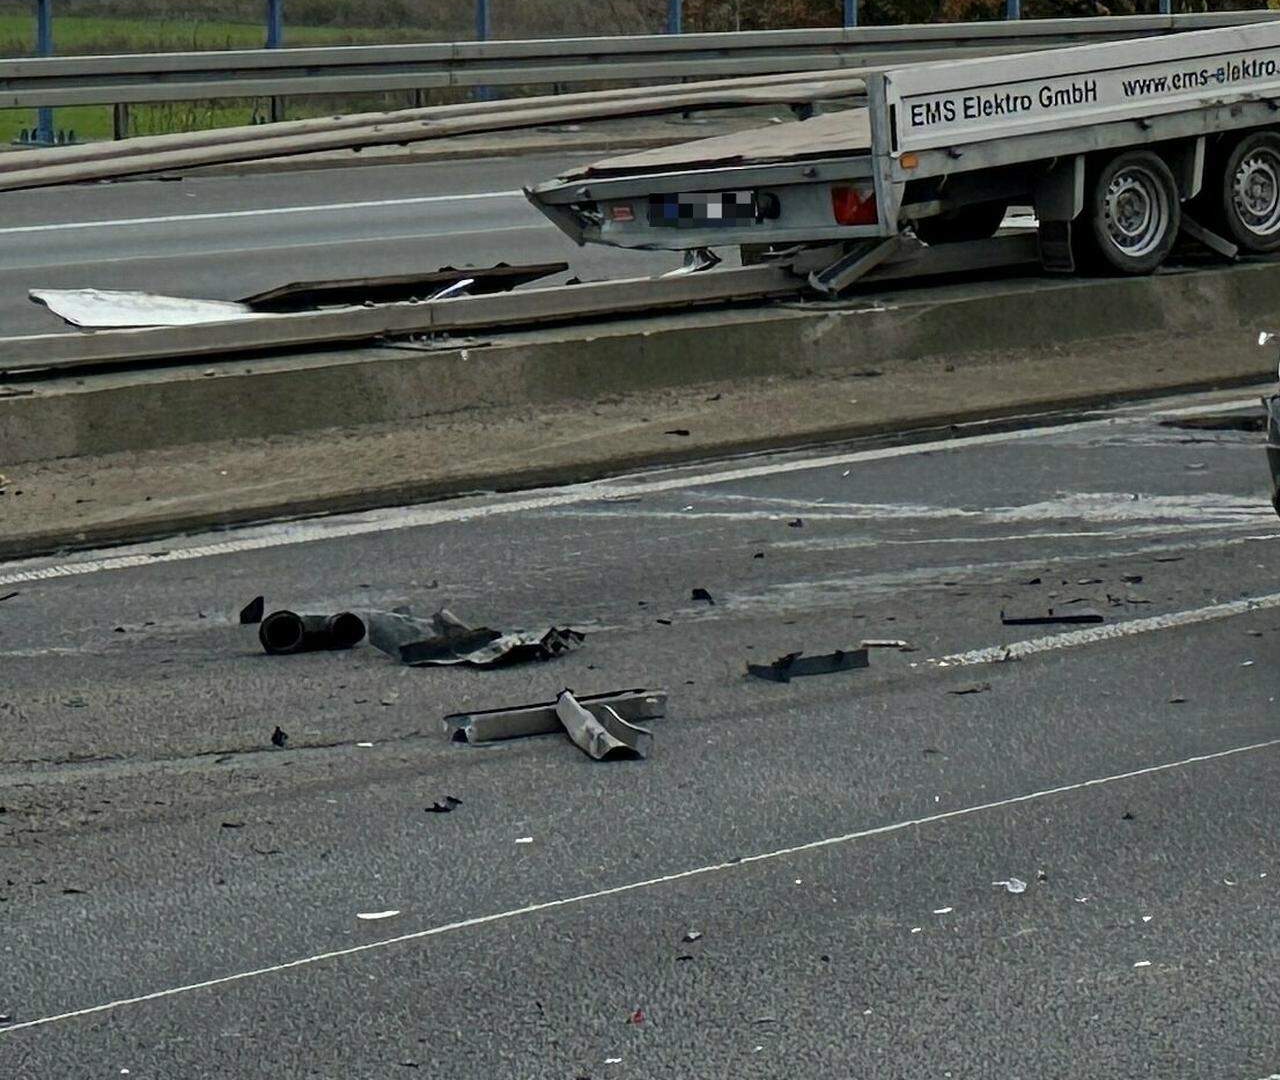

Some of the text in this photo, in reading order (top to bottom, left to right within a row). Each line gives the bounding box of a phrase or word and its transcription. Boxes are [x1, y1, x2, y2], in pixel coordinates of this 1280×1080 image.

[910, 99, 956, 127] EMS
[963, 92, 1033, 120] Elektro
[1038, 79, 1098, 109] GmbH
